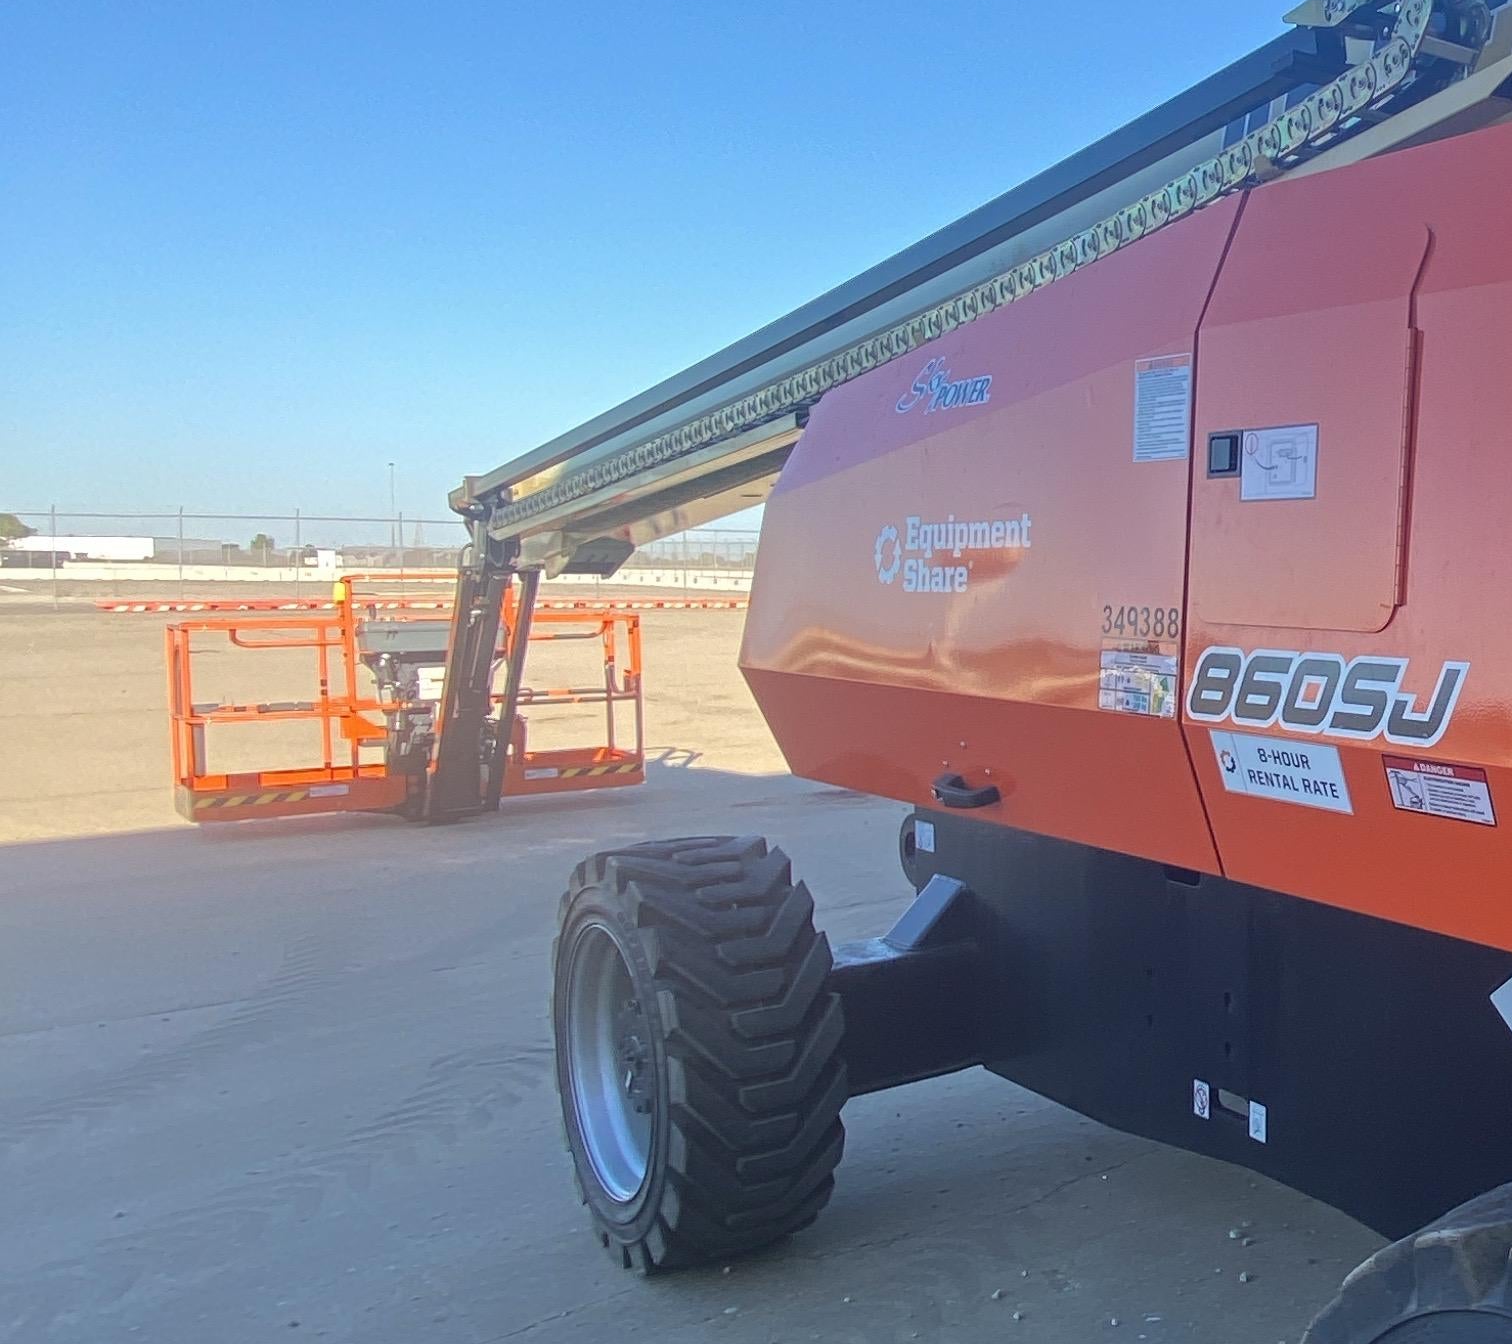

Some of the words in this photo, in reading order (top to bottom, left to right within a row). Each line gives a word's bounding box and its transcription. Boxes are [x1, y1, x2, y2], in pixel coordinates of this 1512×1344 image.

[932, 375, 993, 411] POWER
[904, 512, 1033, 558] Equipment
[902, 558, 969, 593] Share
[1101, 605, 1179, 639] 349388
[1187, 645, 1471, 748] 860SJ
[1256, 747, 1312, 771] 8-HOUR
[1420, 763, 1456, 777] DANGER
[1247, 768, 1300, 793] RENTAL
[1303, 777, 1341, 800] RATE
